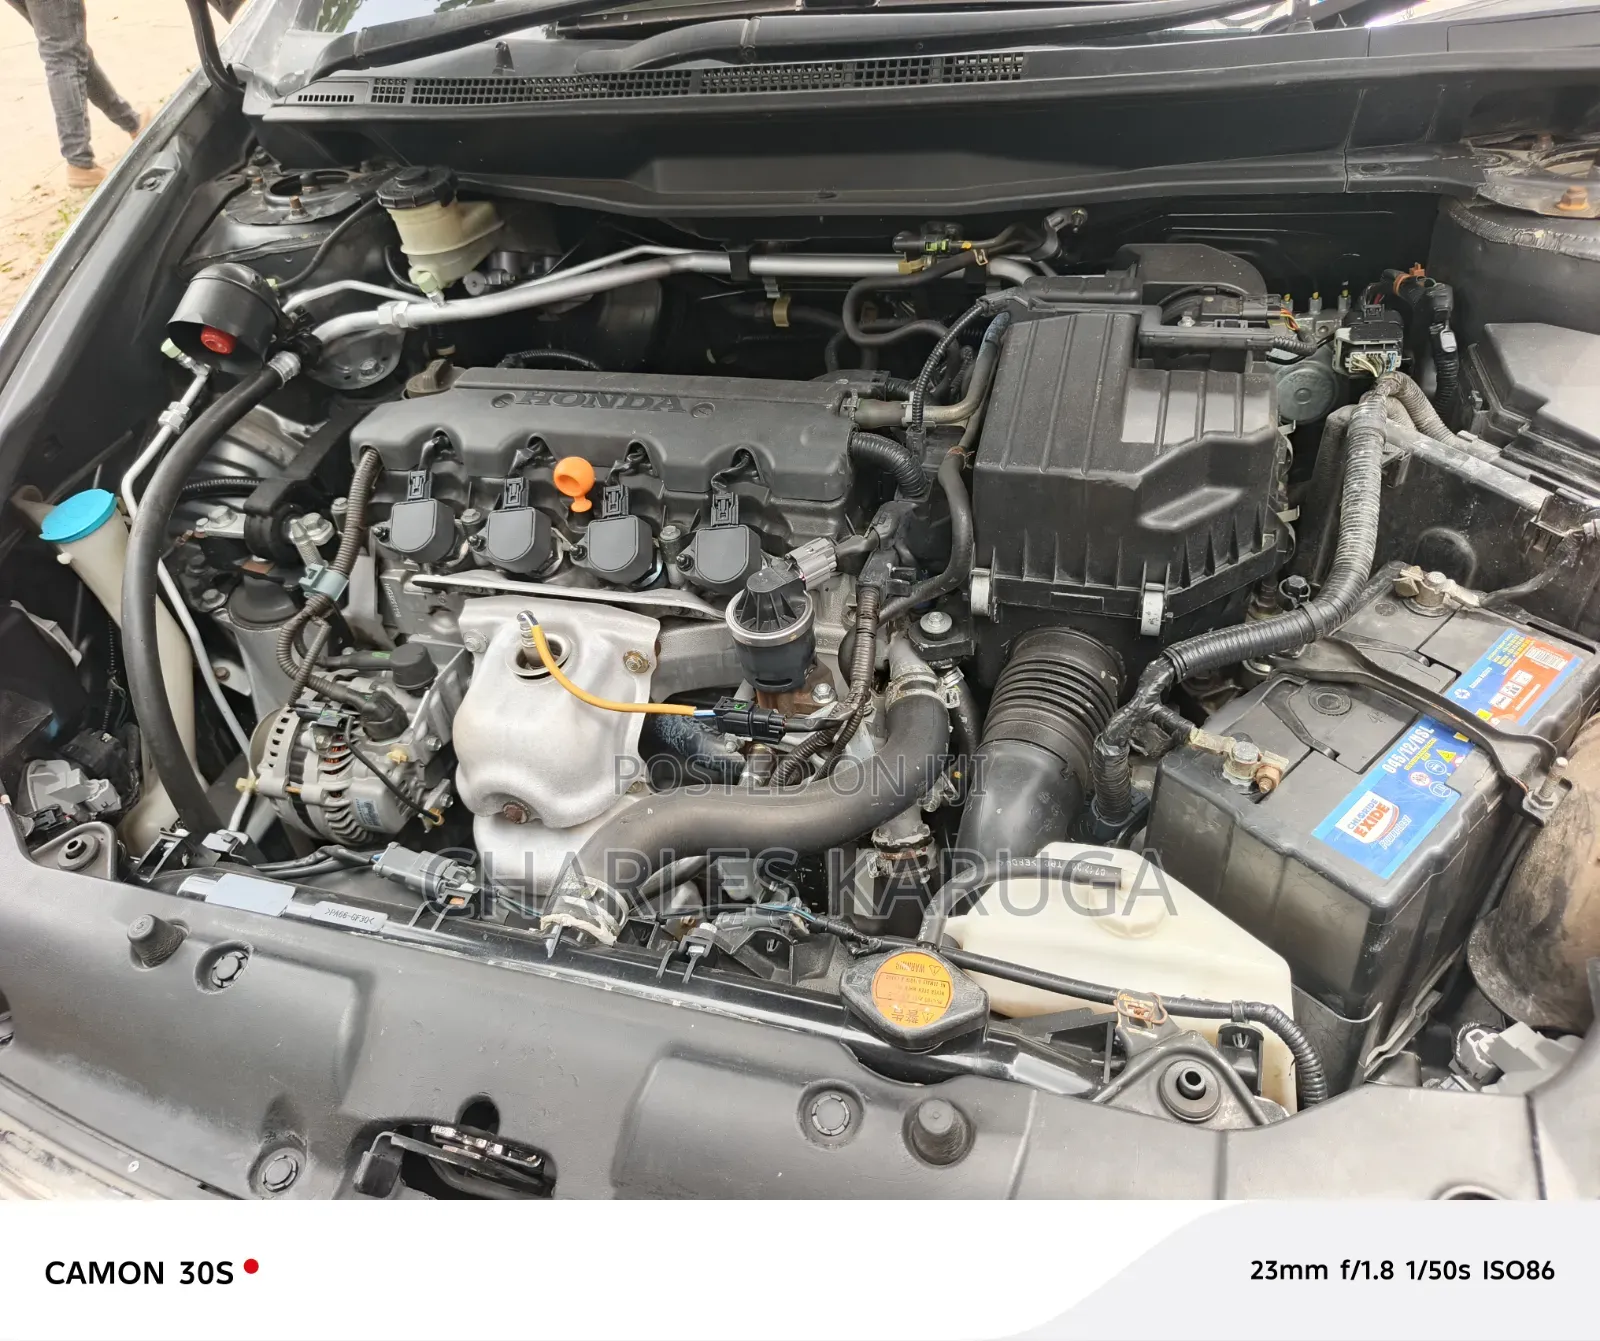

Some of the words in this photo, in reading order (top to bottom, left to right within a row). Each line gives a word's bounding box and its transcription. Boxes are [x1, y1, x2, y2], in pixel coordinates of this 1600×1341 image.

[515, 390, 686, 413] HONDA
[1347, 798, 1378, 830] CHLORIDE
[1353, 802, 1390, 838] EXIDE
[895, 961, 926, 973] WARNING
